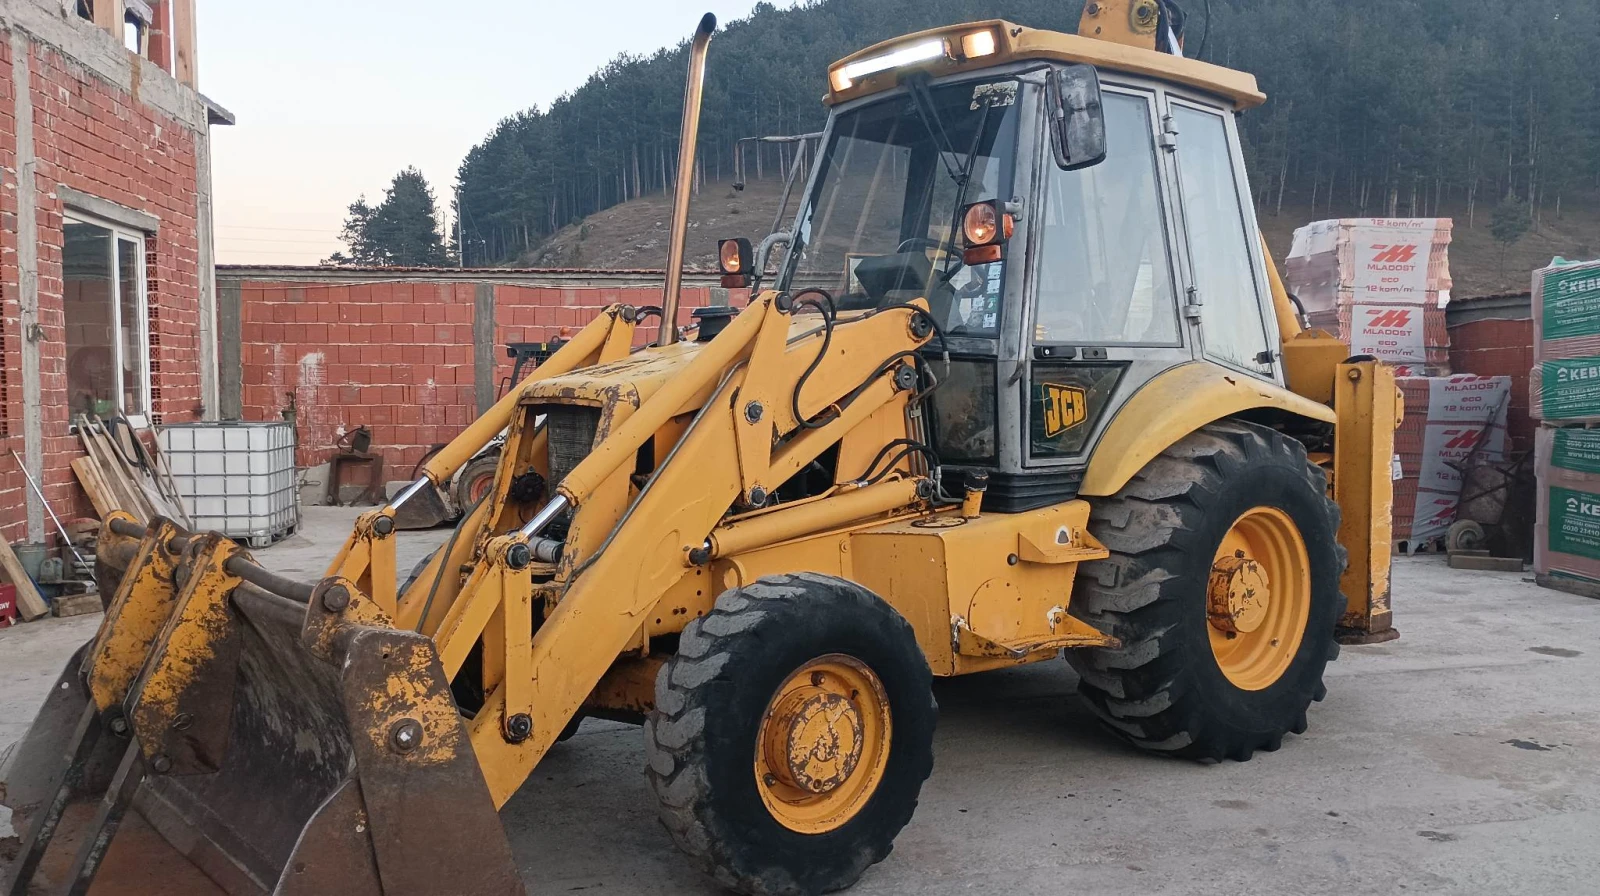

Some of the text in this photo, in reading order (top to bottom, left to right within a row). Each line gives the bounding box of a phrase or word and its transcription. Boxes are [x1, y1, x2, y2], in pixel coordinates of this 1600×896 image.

[1363, 328, 1412, 336] MLADOST
[1571, 366, 1600, 380] KEB
[1444, 382, 1501, 392] MLADOST
[1047, 387, 1084, 434] JCB
[1439, 450, 1490, 460] MLADST
[1436, 471, 1449, 480] 12
